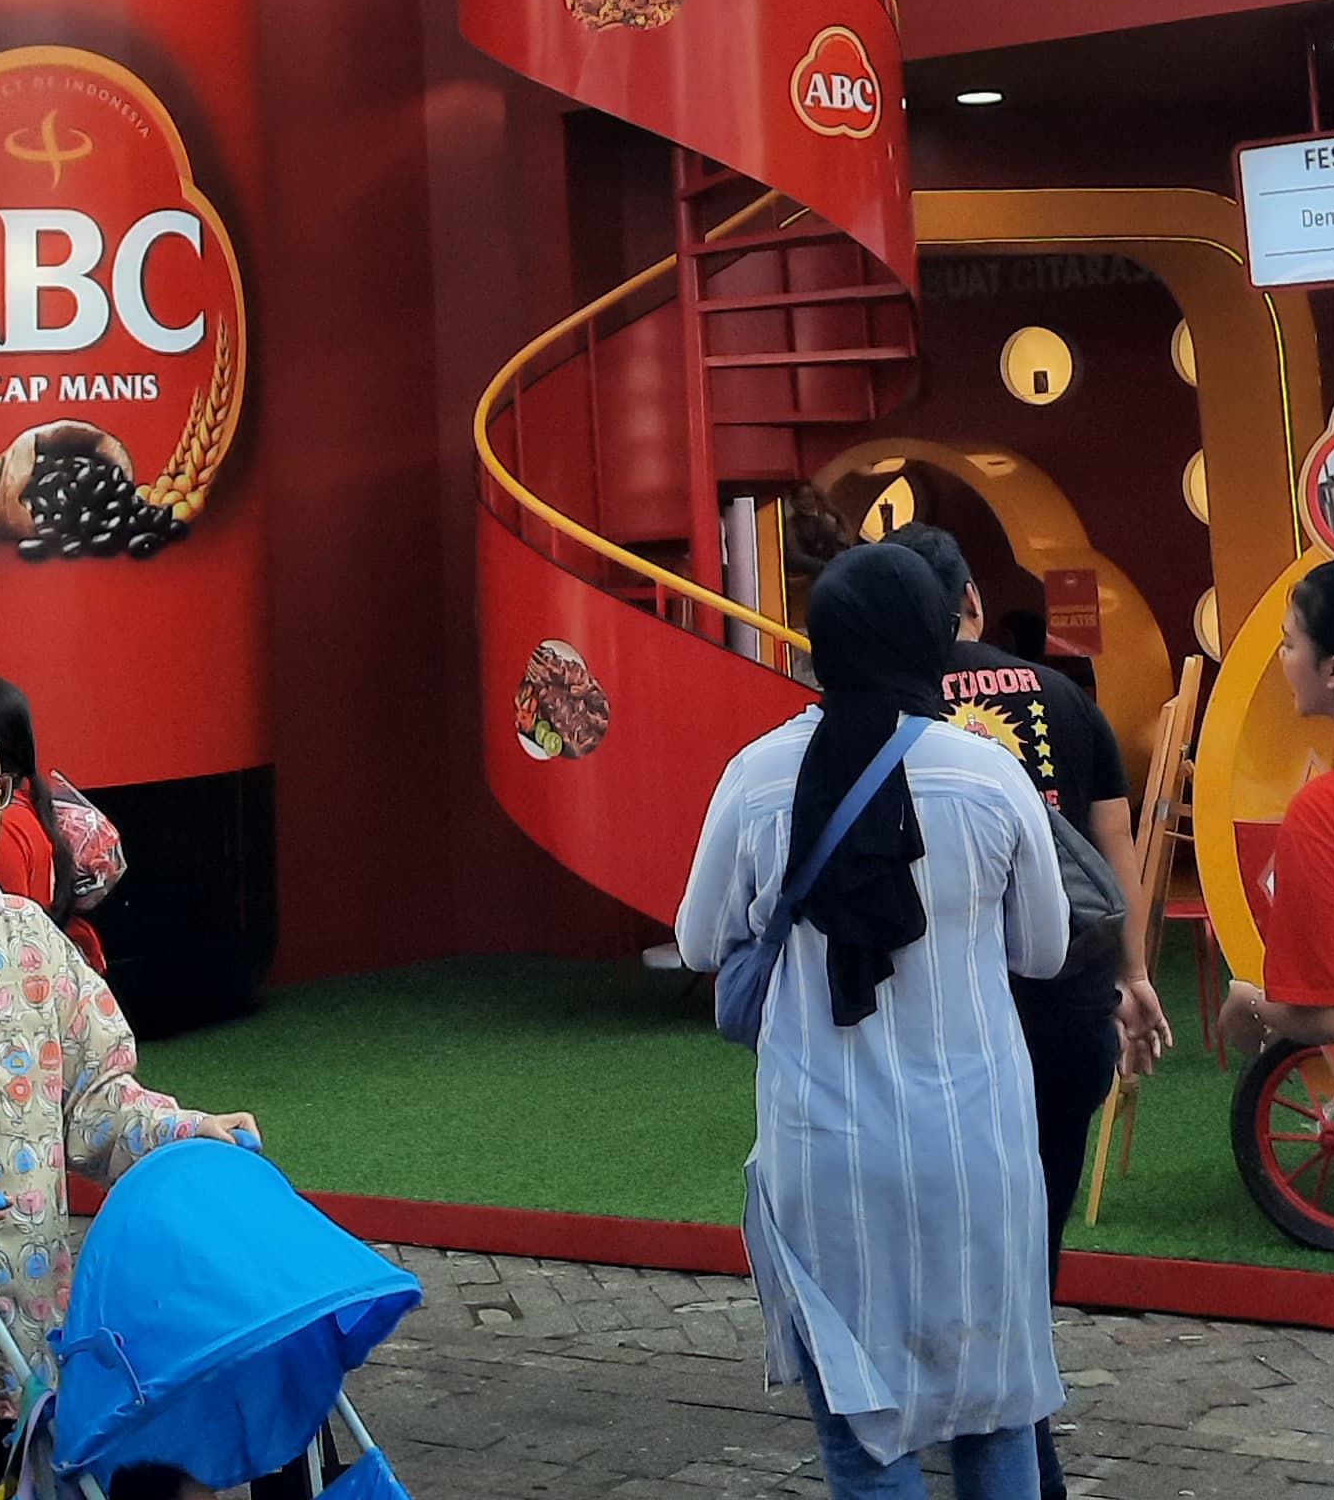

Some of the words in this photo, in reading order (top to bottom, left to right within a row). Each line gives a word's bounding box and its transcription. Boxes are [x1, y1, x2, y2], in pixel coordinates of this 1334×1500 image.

[33, 75, 56, 89] OF
[65, 76, 152, 139] INDONESIA
[803, 72, 874, 114] ABC
[58, 373, 159, 403] MANIS
[1049, 614, 1099, 628] GRATIS
